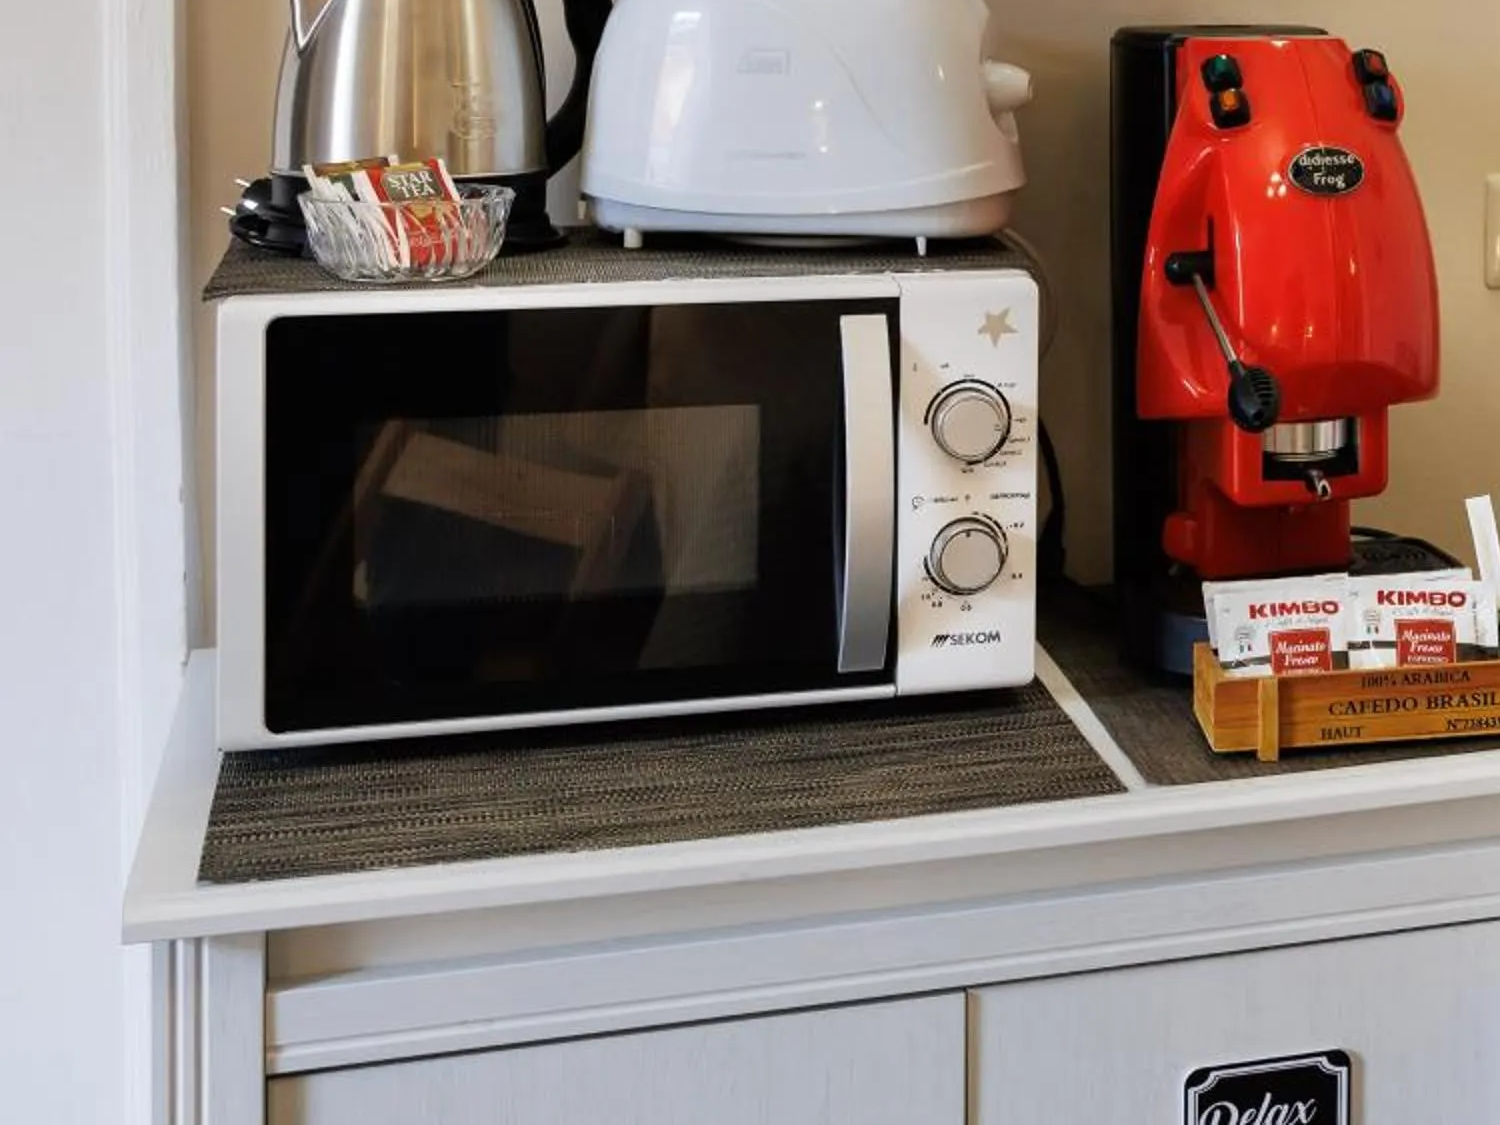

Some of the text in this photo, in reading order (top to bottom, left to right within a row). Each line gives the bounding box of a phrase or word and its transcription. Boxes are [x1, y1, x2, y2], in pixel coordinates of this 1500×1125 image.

[387, 170, 433, 189] STAR
[400, 184, 436, 198] TEA
[1376, 590, 1467, 607] KIMBO
[1248, 601, 1340, 619] KIMBO
[950, 631, 1001, 646] SEKOM
[1402, 670, 1471, 686] ARABICA
[1320, 726, 1362, 740] HAUT
